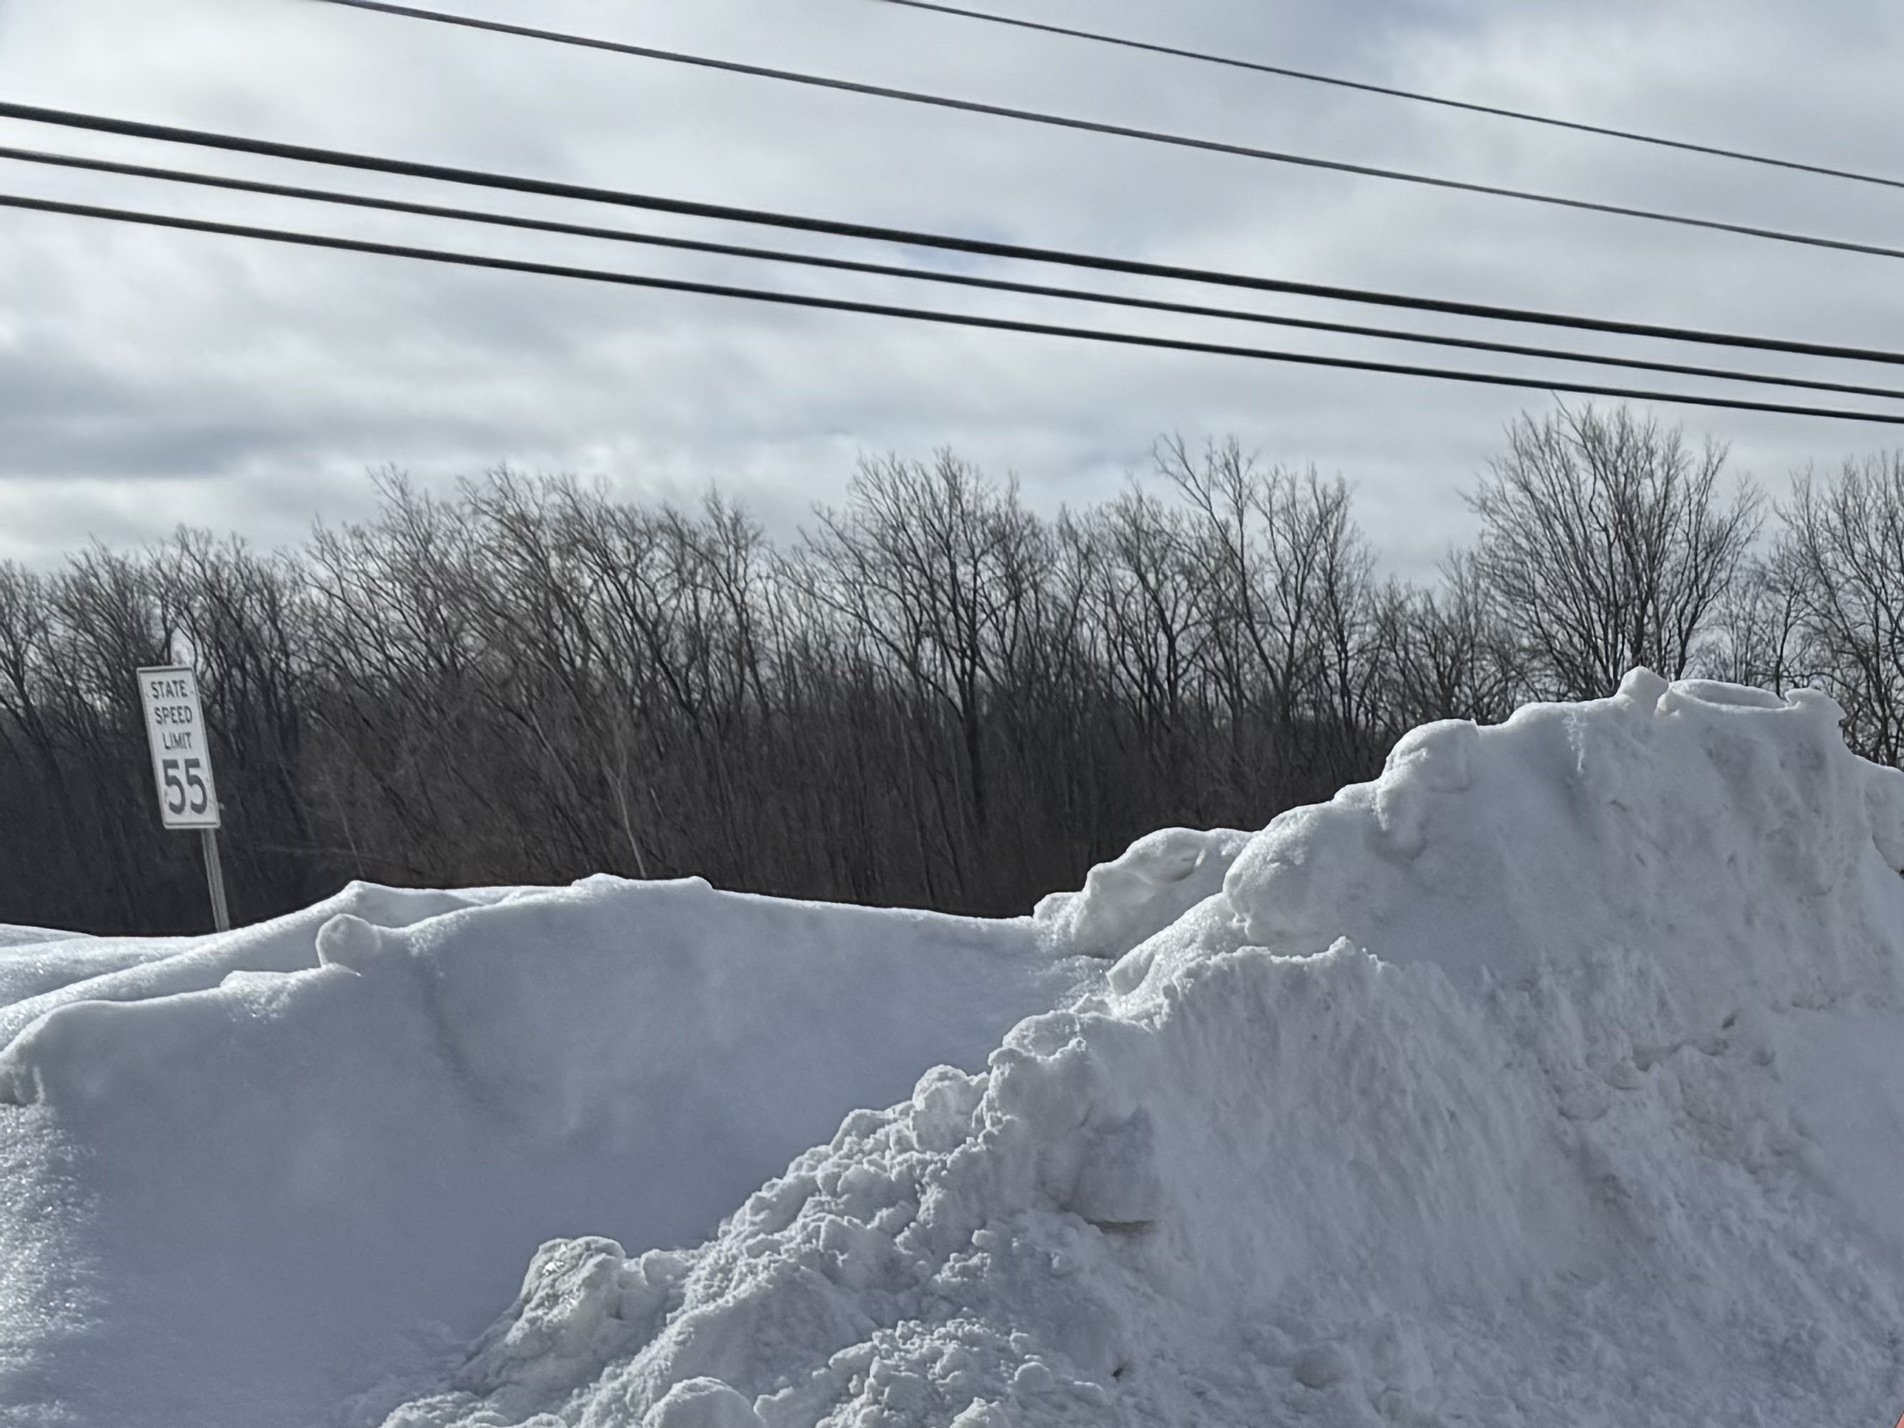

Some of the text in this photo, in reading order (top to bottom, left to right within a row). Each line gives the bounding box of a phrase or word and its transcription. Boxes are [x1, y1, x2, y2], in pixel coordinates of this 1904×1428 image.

[150, 679, 188, 699] STATE
[154, 706, 193, 725] SPEED
[162, 732, 192, 751] LIMIT
[162, 758, 208, 815] 55
